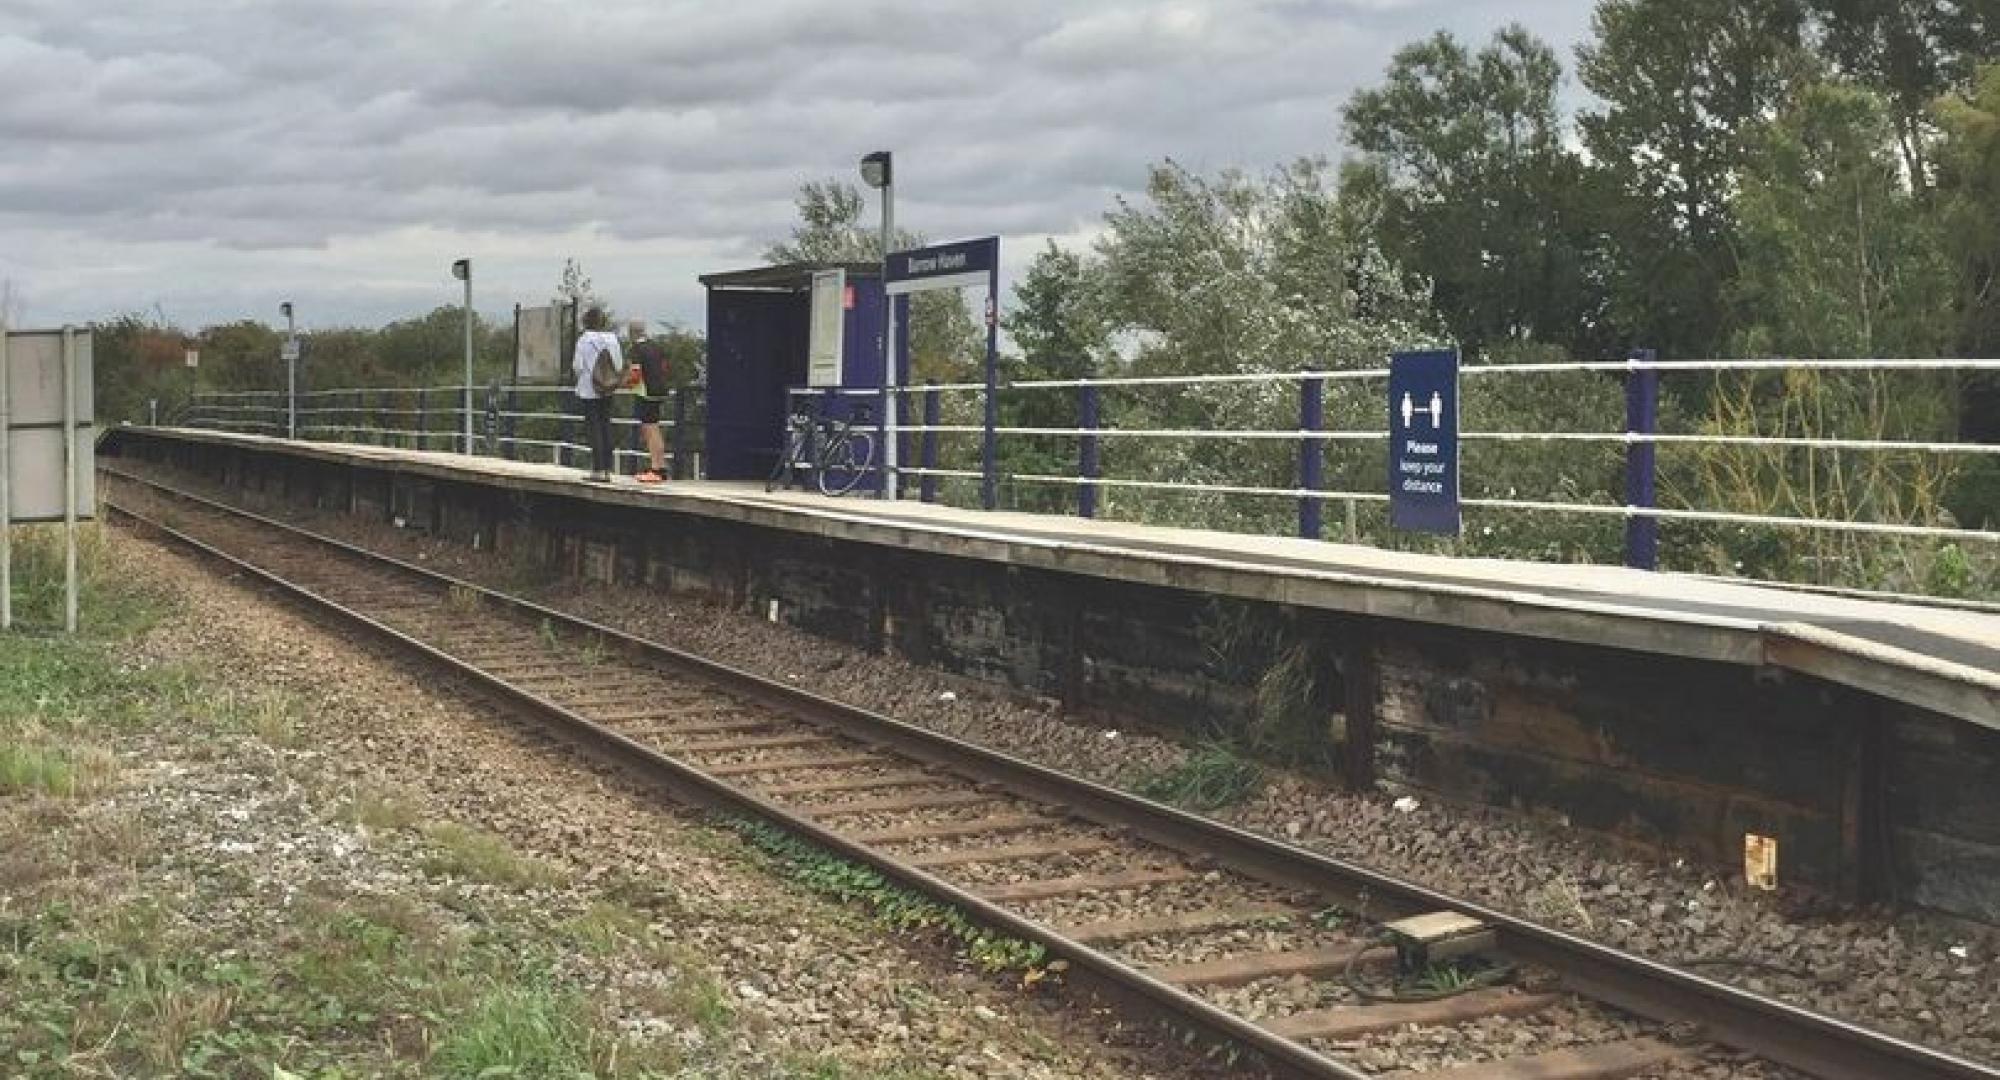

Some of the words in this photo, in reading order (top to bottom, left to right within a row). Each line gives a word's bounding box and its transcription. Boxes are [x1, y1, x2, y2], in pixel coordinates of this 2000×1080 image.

[1407, 440, 1438, 454] Please
[1400, 458, 1421, 474] keep
[1422, 463, 1445, 475] your
[1402, 478, 1443, 493] distance
